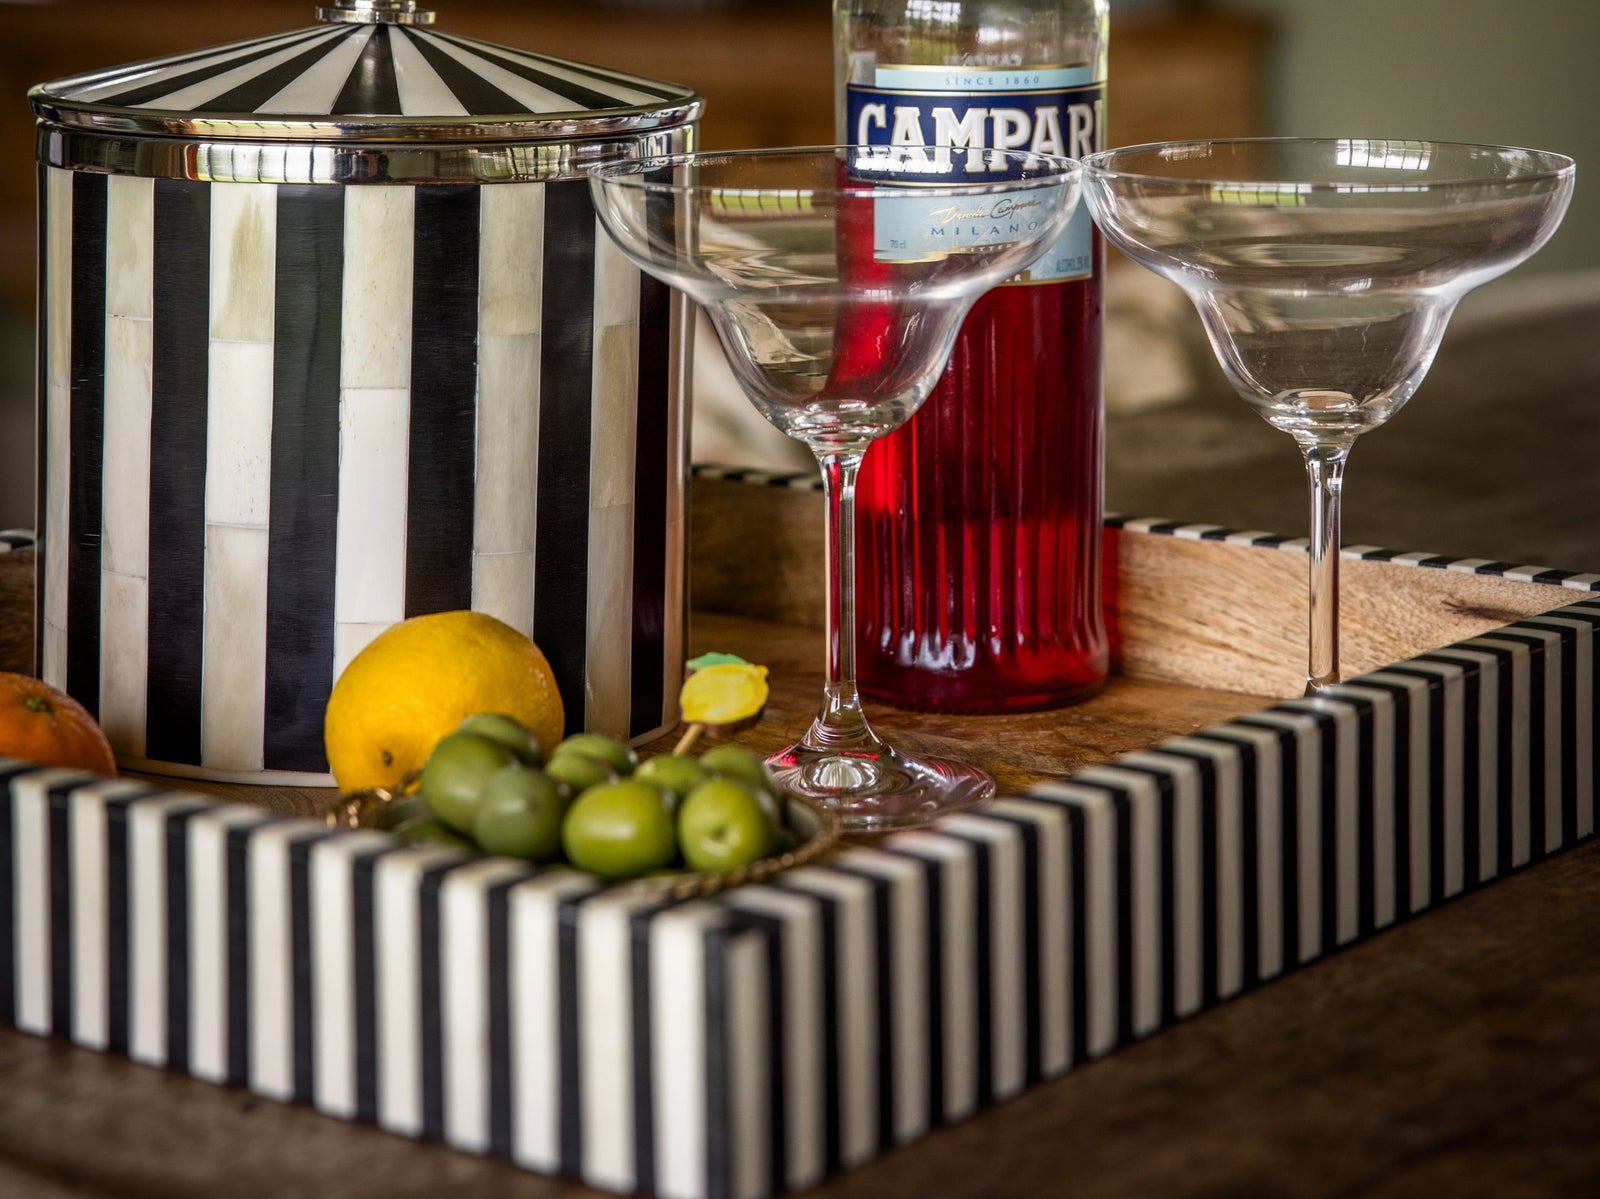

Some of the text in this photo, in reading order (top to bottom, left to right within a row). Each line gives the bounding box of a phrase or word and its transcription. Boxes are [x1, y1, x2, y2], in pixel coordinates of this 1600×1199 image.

[945, 75, 1040, 85] SINCE 1860
[930, 221, 1038, 236] MILANO
